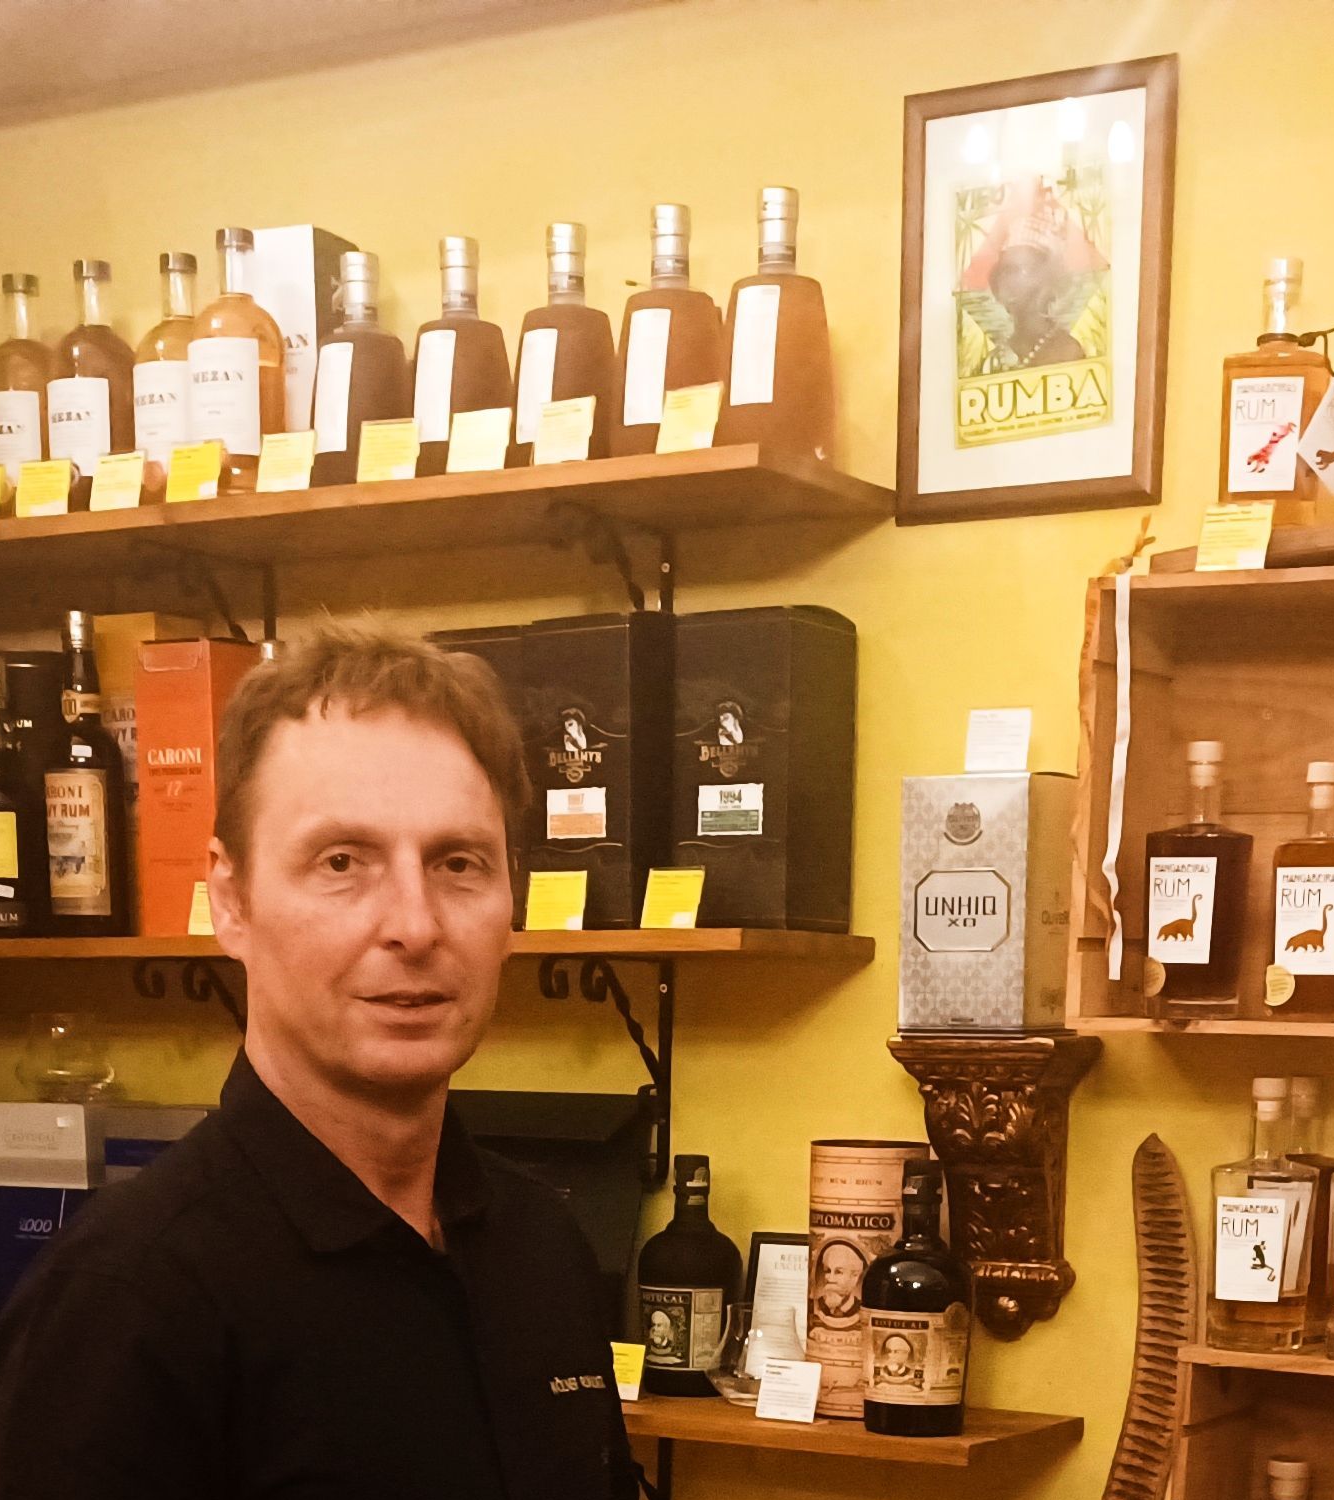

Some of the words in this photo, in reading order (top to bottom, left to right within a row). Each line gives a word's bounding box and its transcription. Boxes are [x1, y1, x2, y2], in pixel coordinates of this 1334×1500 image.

[960, 368, 1107, 427] RUMBA
[1235, 399, 1276, 421] RUM
[147, 747, 202, 765] CARONI
[62, 804, 91, 817] RUM
[1154, 864, 1211, 874] MANGABEIRAS
[1153, 878, 1190, 898] RUM
[925, 896, 998, 916] UNHIQ
[1281, 888, 1321, 909] RUM
[947, 918, 977, 928] XO
[1222, 1204, 1279, 1215] MANGABEIRAS
[812, 1212, 891, 1229] IPLOMÁTICO
[1221, 1216, 1259, 1238] RUM
